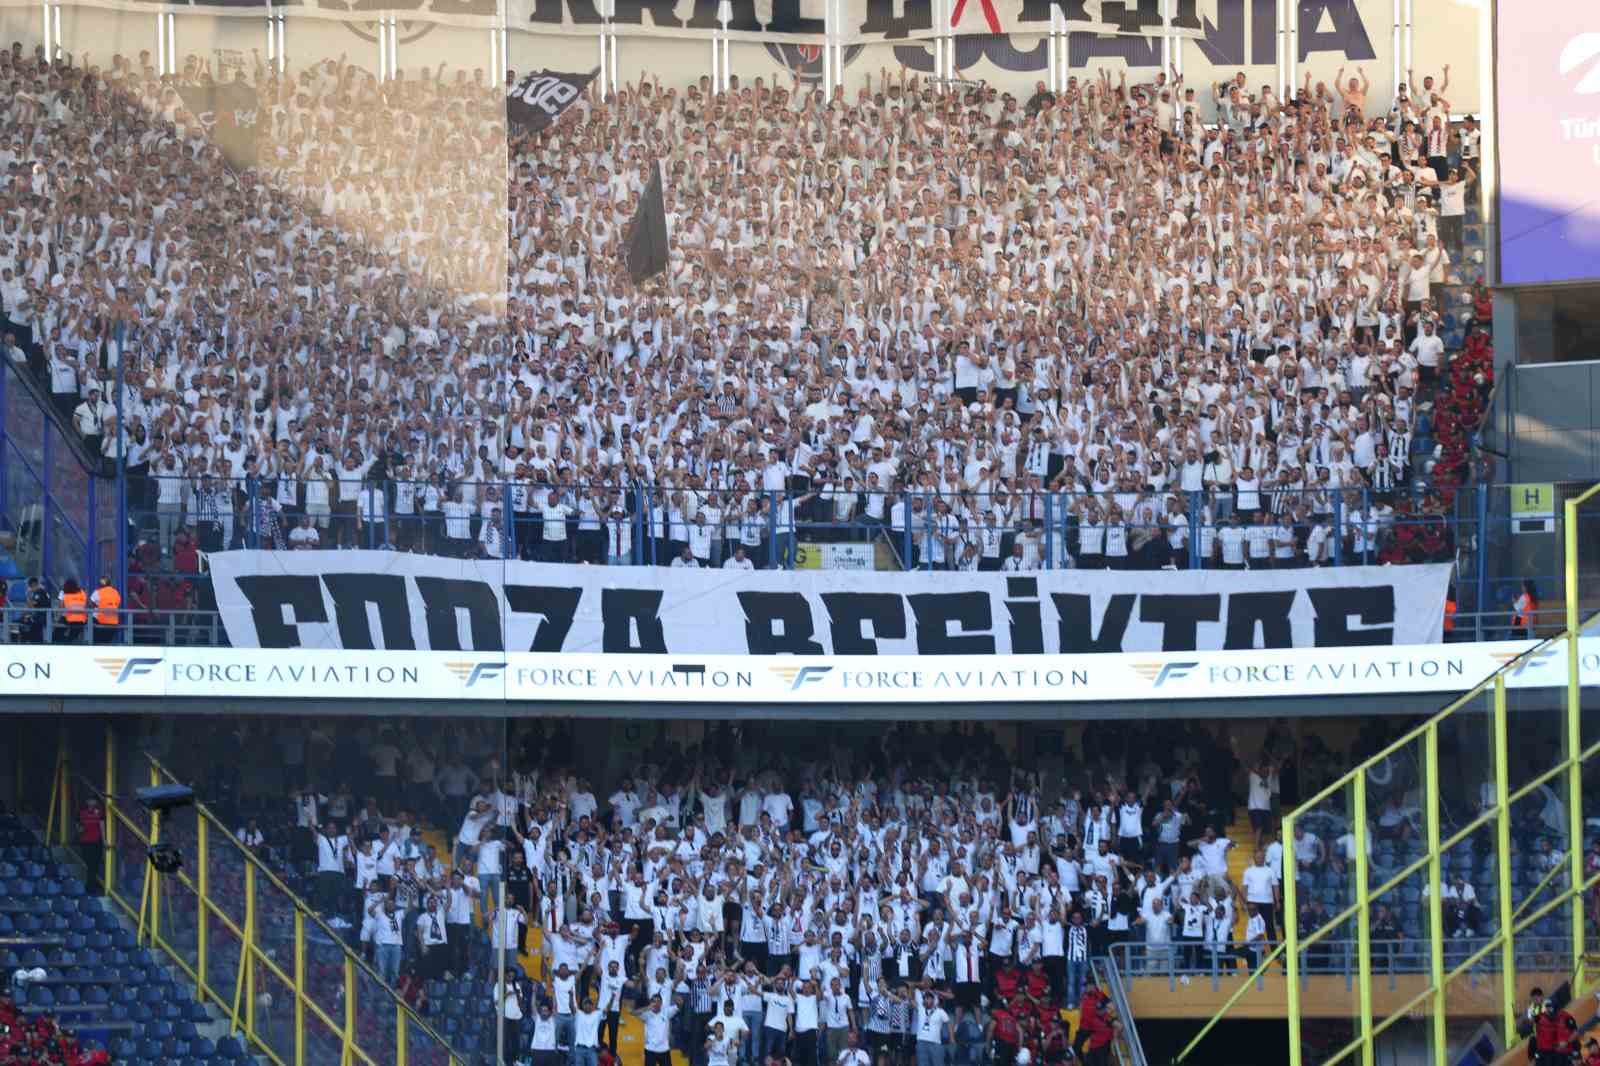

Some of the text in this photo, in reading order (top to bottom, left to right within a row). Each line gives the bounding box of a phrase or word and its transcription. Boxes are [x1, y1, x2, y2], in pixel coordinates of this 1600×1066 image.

[1524, 487, 1540, 505] H
[172, 664, 257, 682] FORCE
[267, 665, 418, 684] AVIATION
[518, 668, 596, 686] FORCE
[608, 669, 752, 688] AVIATION
[843, 671, 922, 688] FORCE
[935, 669, 1088, 687] AVIATION
[1208, 664, 1294, 683] FORCE
[1310, 658, 1463, 680] AVIATION
